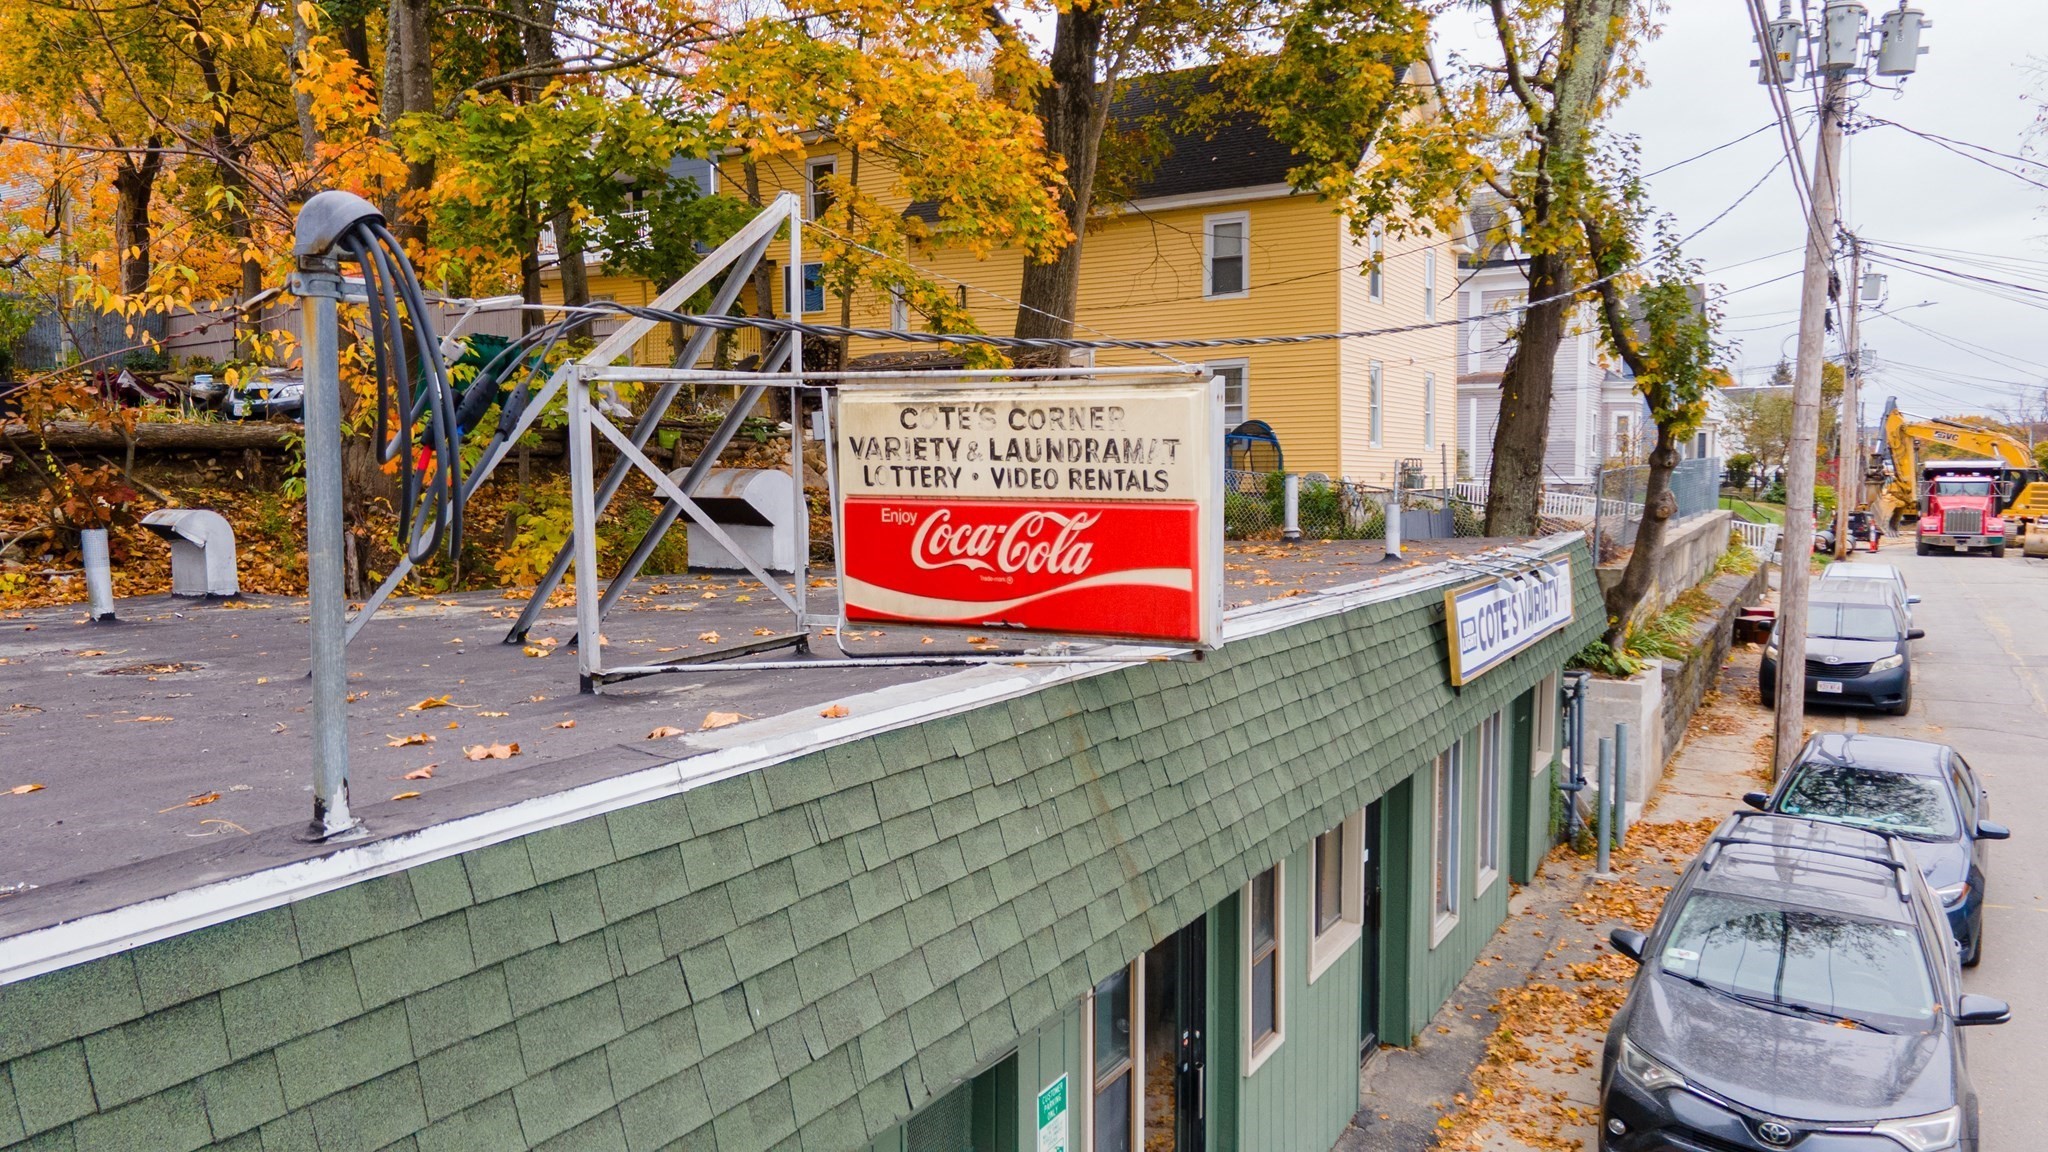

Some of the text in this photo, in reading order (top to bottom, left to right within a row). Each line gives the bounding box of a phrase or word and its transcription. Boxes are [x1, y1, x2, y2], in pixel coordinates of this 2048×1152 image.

[900, 405, 1126, 432] COTE'S CORNER
[848, 436, 961, 462] VARIETY
[967, 441, 983, 462] &
[863, 464, 1169, 493] LOTTERY VIDEO RENTALS
[880, 507, 918, 527] Enjoy
[911, 508, 1103, 576] Coca-Cola
[1478, 594, 1519, 651] COTE'S
[1518, 577, 1560, 630] VARIETY
[1043, 1092, 1062, 1114] PARKING
[1047, 1106, 1059, 1121] ONLY
